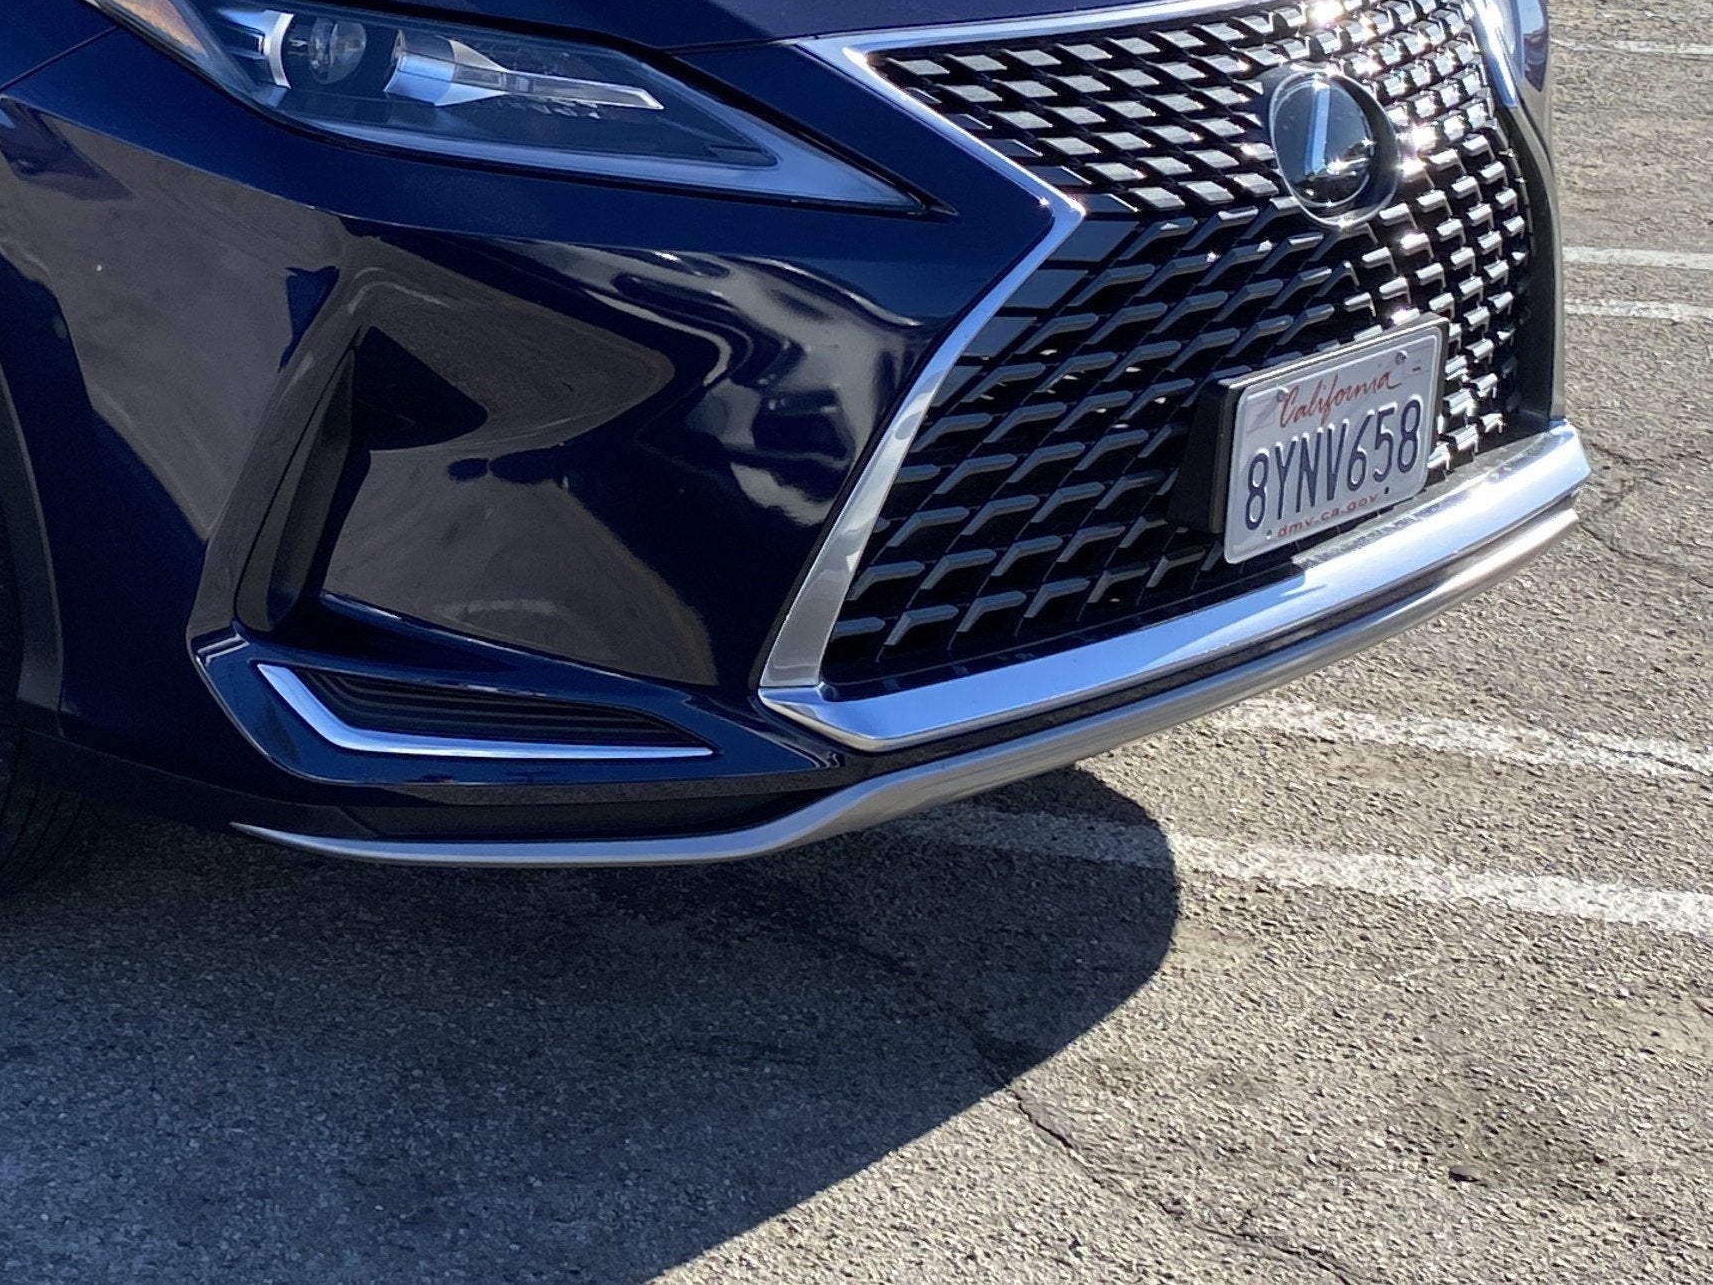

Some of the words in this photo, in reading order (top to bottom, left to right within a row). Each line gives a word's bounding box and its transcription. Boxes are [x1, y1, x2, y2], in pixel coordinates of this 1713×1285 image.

[1278, 369, 1402, 428] California
[1245, 395, 1422, 531] 8YNV658
[1276, 493, 1379, 539] dmv.ca.gov
